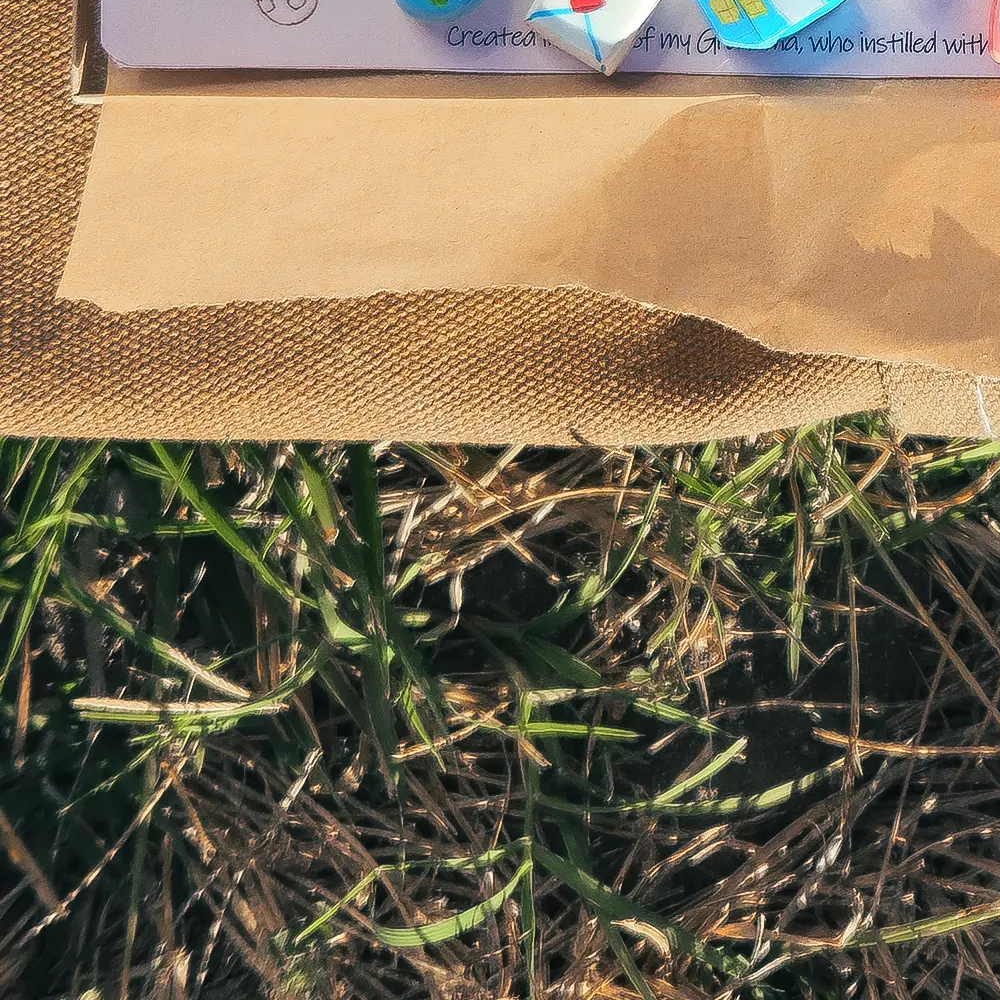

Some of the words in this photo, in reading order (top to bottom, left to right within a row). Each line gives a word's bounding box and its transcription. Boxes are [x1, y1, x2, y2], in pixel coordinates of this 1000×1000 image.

[660, 31, 692, 56] my
[808, 30, 854, 54] who
[859, 30, 938, 55] instilled
[941, 32, 989, 56] with
